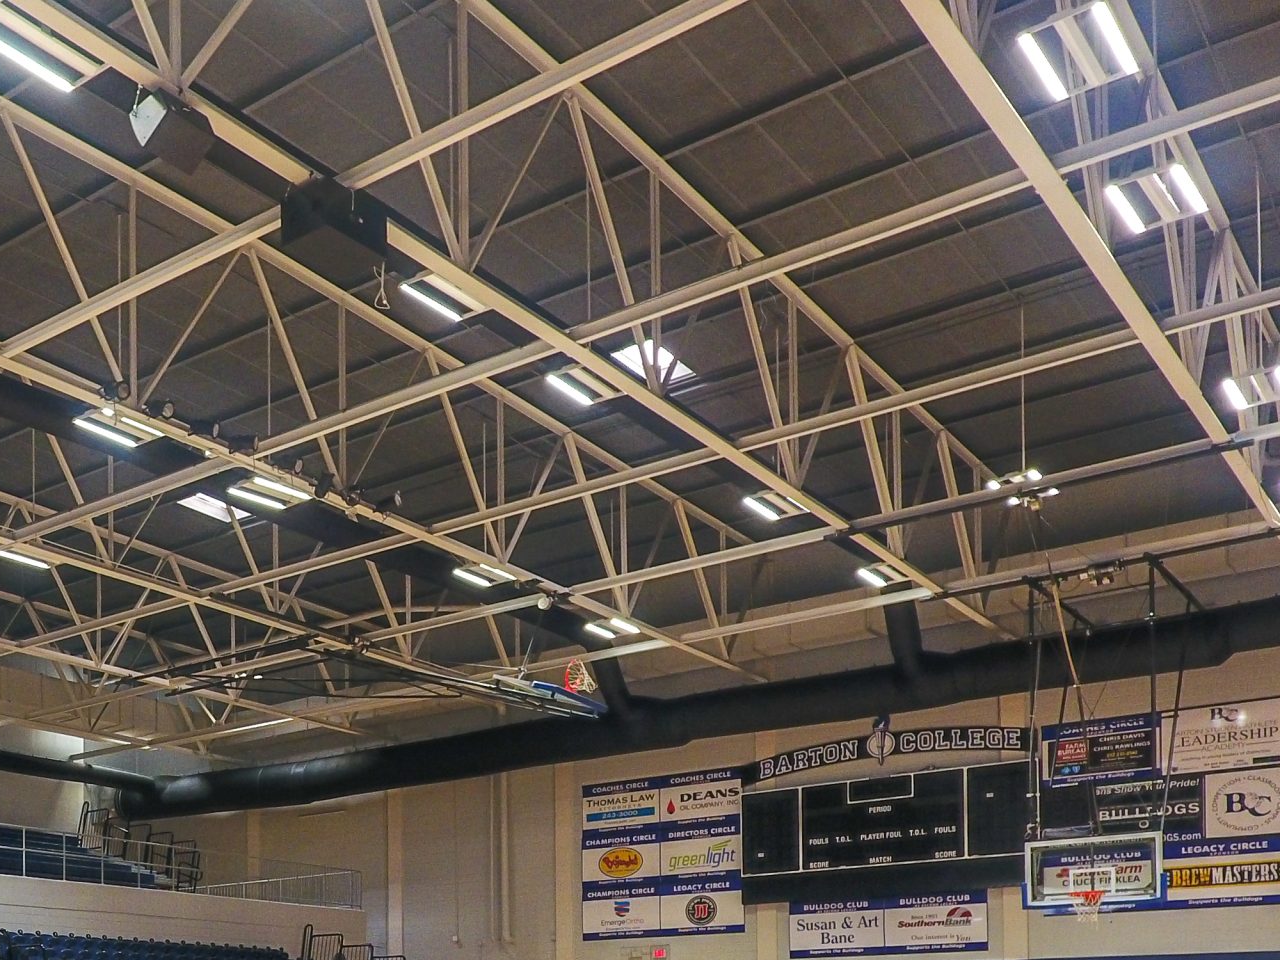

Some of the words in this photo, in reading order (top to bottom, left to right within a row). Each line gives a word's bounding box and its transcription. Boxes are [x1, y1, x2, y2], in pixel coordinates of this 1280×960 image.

[1176, 726, 1279, 747] EADERSHIP
[1115, 741, 1151, 749] RAWLINGS
[760, 740, 858, 779] BARTON
[900, 728, 1021, 753] COLLEGE
[670, 775, 704, 785] COACHES
[706, 771, 731, 781] CIRCLE
[1145, 782, 1166, 791] Yur
[1170, 778, 1200, 788] Pride!
[592, 785, 624, 794] COACHES
[625, 781, 649, 790] CIRCLE
[586, 796, 628, 808] THOMAS
[630, 793, 655, 803] LAW
[680, 787, 740, 803] DEANS
[691, 802, 723, 810] COMPANY
[869, 805, 892, 813] PERIOD
[1224, 792, 1272, 817] BC
[668, 829, 709, 839] DIRECTORS
[710, 826, 736, 834] CIRCLE
[809, 837, 829, 845] FOULS
[860, 833, 885, 841] PLAYER
[934, 825, 956, 834] FOULS
[586, 836, 631, 846] CHAMPIONS
[632, 834, 656, 842] CIRCLE
[1181, 844, 1225, 854] LEGACY
[1230, 841, 1269, 851] CIRCLE
[668, 846, 736, 872] greenlight
[809, 861, 829, 869] SCORE
[869, 856, 892, 864] MATCH
[935, 850, 957, 858] SCORE
[1061, 854, 1111, 863] BULLOG
[1114, 851, 1141, 860] CLUB
[1172, 863, 1280, 887] BREWMASTERS
[673, 884, 703, 892] LEGACY
[705, 881, 730, 889] CIRCLE
[1062, 878, 1091, 887] CUC
[587, 889, 630, 898] CHAMPIONS
[631, 887, 655, 895] CIRCLE
[803, 902, 844, 911] BULLDOG
[846, 901, 869, 909] CLUB
[899, 896, 944, 905] BULLDOG
[946, 894, 970, 902] CLUB
[796, 918, 836, 932] Susan
[841, 916, 853, 929] &
[857, 915, 879, 928] Art
[821, 931, 855, 945] Bane
